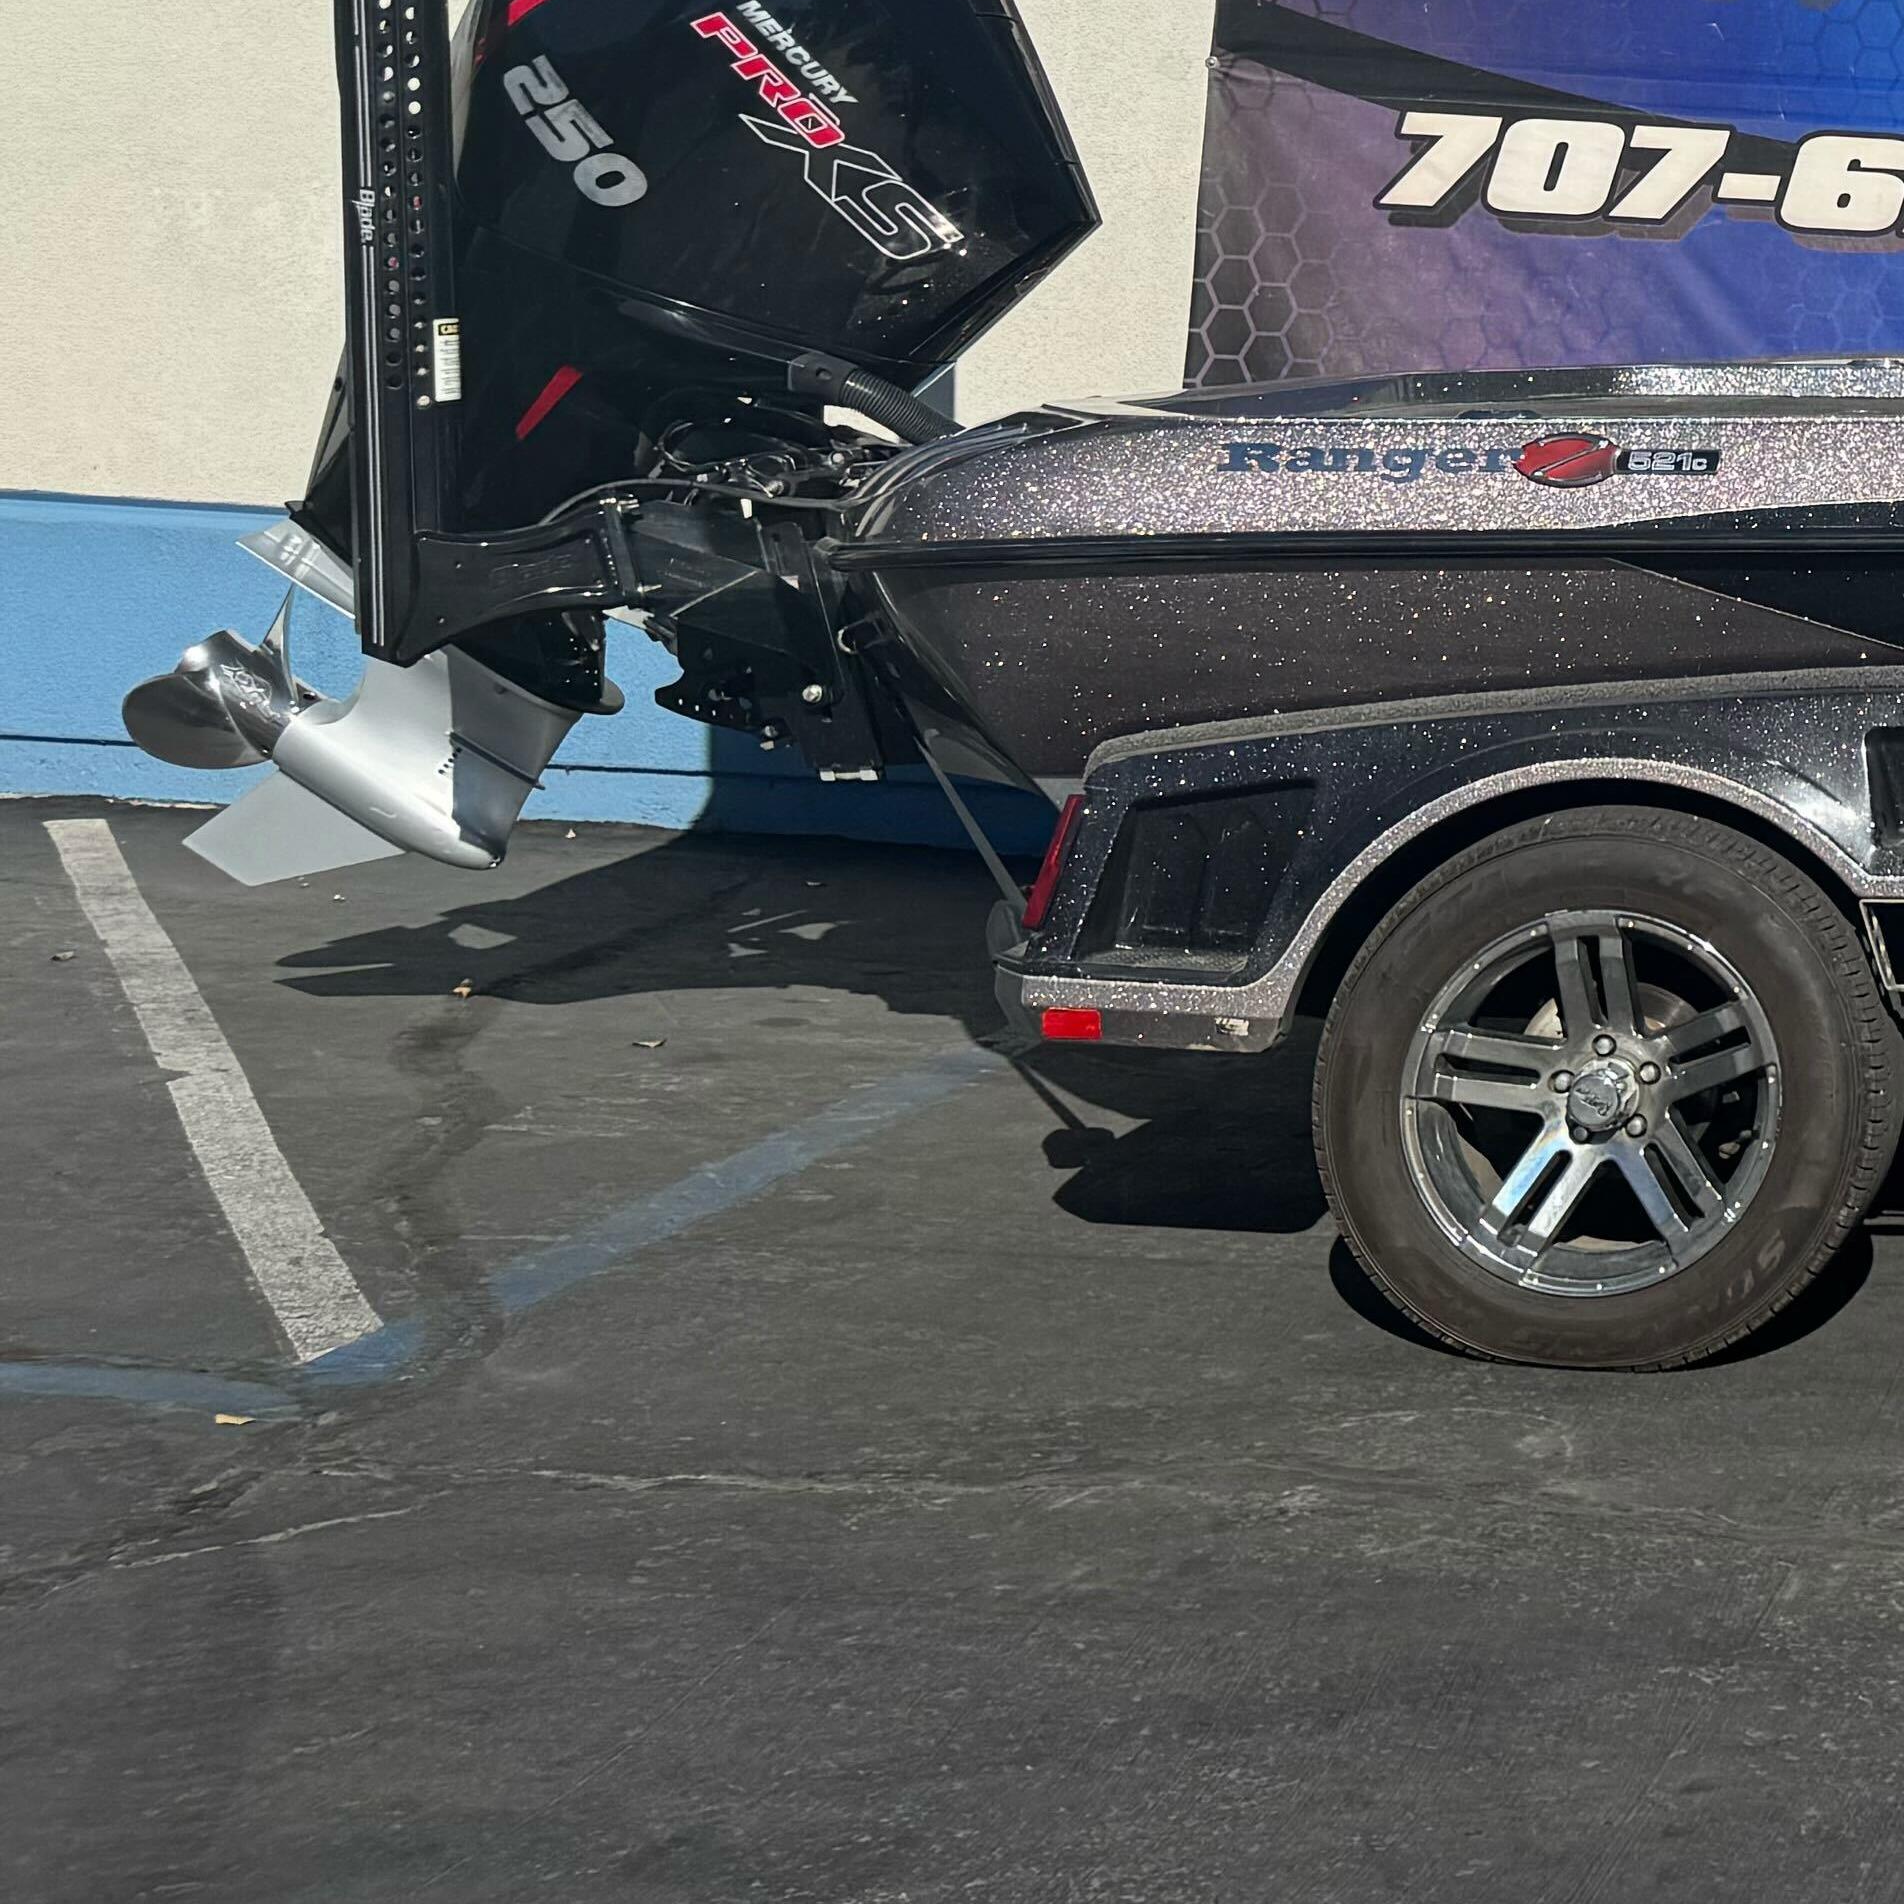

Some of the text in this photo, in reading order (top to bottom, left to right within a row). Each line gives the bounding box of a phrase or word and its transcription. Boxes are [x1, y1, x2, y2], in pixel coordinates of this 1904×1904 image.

[689, 11, 846, 149] PRO
[736, 0, 861, 106] MERCURY
[502, 54, 648, 207] 250
[738, 112, 966, 260] XS
[1216, 442, 1524, 484] Ranger
